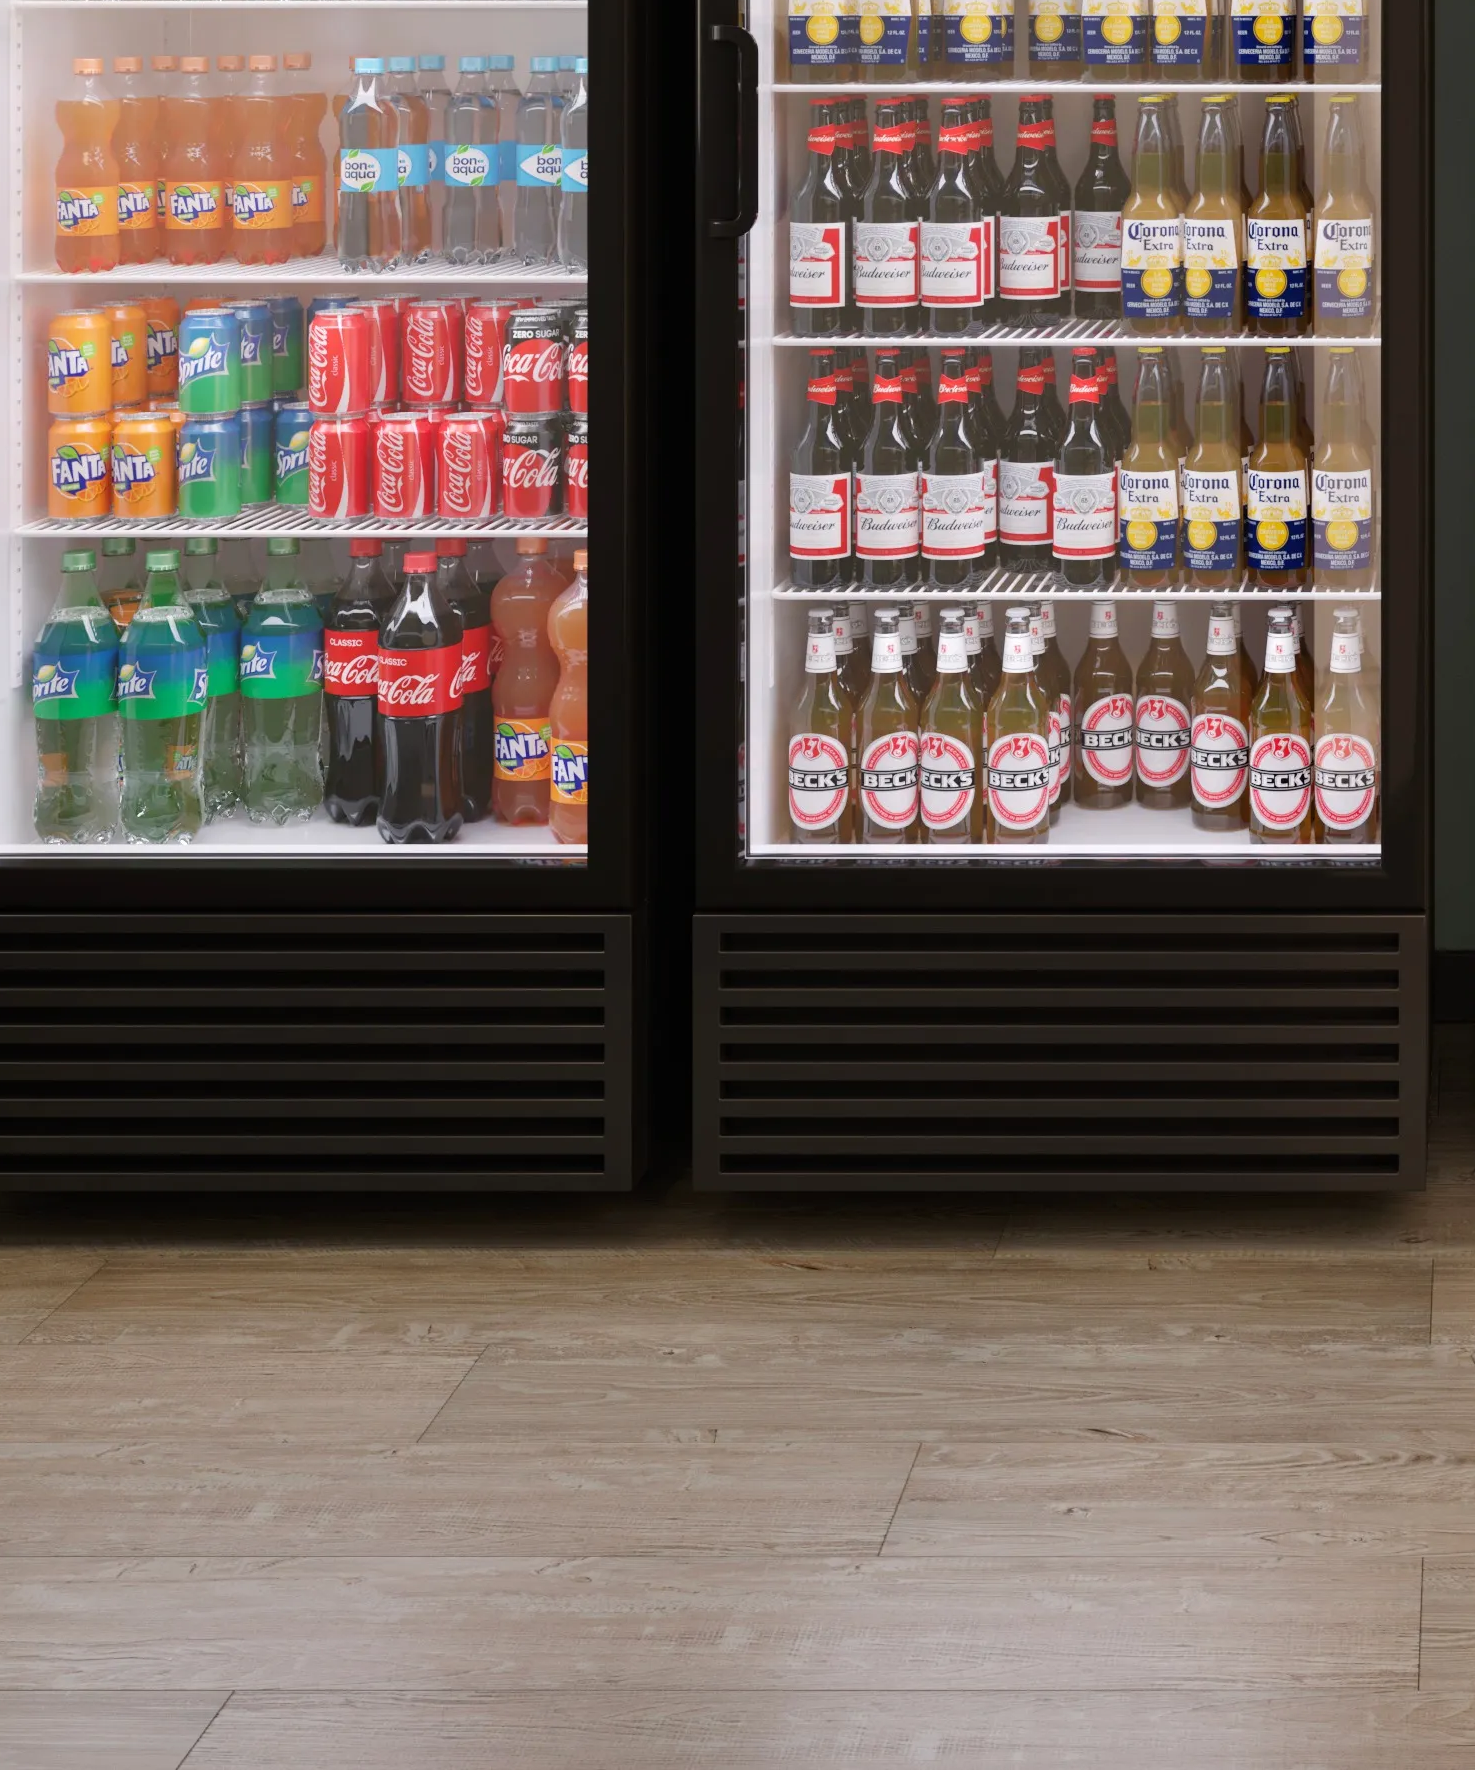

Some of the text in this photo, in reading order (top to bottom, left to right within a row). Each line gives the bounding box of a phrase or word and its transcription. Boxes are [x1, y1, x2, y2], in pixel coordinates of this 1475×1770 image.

[345, 161, 367, 172] bon
[345, 168, 376, 182] aqua
[171, 192, 217, 215] FANTA
[853, 266, 911, 280] Budweiser
[513, 329, 559, 339] ZERO SUGAR
[179, 353, 222, 383] Sprite
[309, 325, 327, 407] Coca-Cola
[444, 427, 471, 512] Coca-Cola
[330, 638, 363, 648] CLASSIC
[1315, 769, 1375, 788] BECK'S
